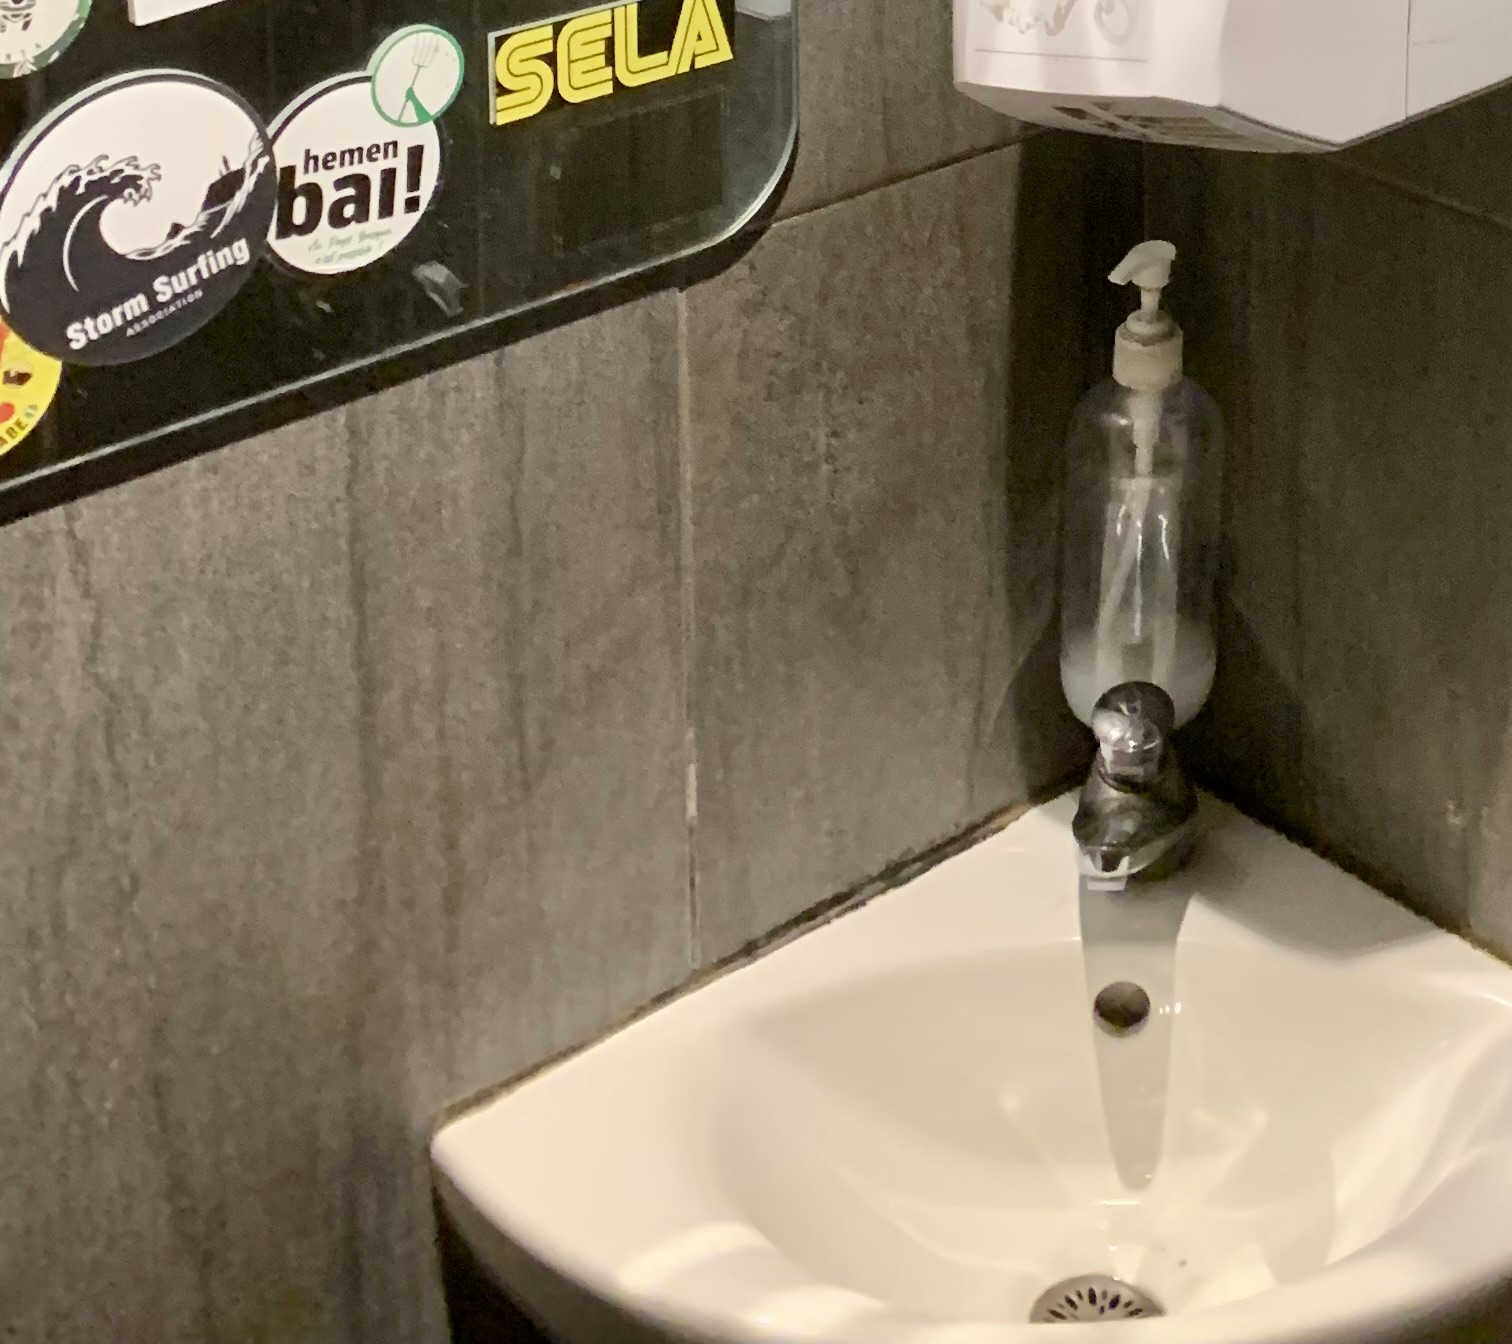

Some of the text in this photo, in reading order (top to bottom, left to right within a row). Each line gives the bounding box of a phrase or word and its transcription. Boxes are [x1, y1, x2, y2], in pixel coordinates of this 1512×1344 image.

[275, 144, 424, 240] bai!
[303, 140, 398, 175] hemen
[66, 292, 150, 351] Storm
[153, 237, 250, 303] Surfing
[126, 288, 204, 337] ASSOCIATION
